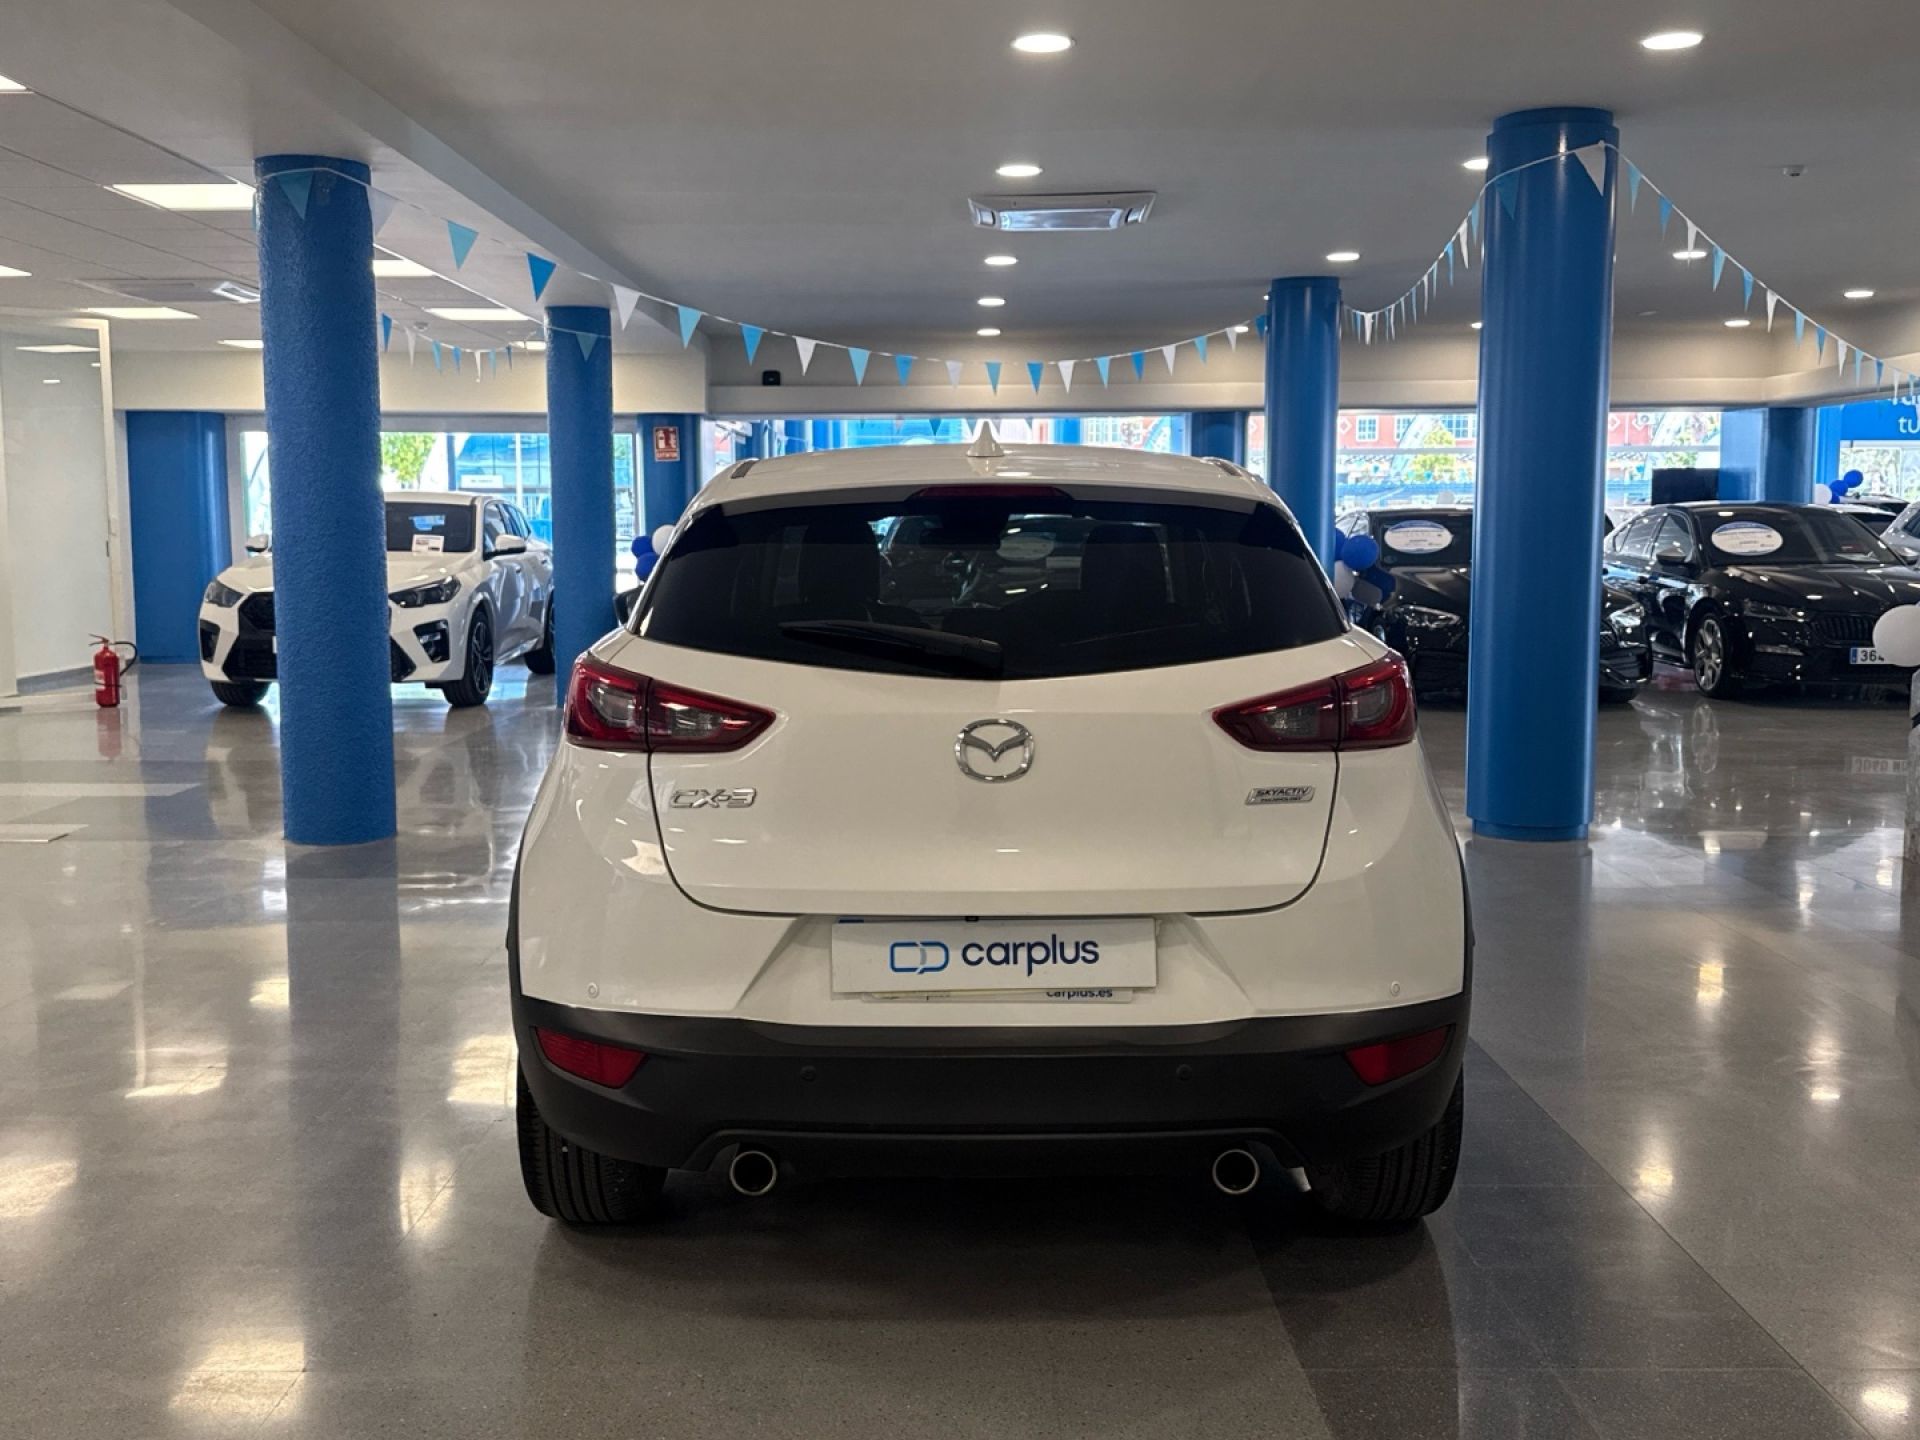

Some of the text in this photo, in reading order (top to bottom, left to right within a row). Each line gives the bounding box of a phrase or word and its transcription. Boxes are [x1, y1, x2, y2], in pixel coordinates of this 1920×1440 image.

[671, 787, 756, 808] CX-3
[1255, 787, 1312, 797] SKYACTIV
[961, 933, 1099, 977] carplus
